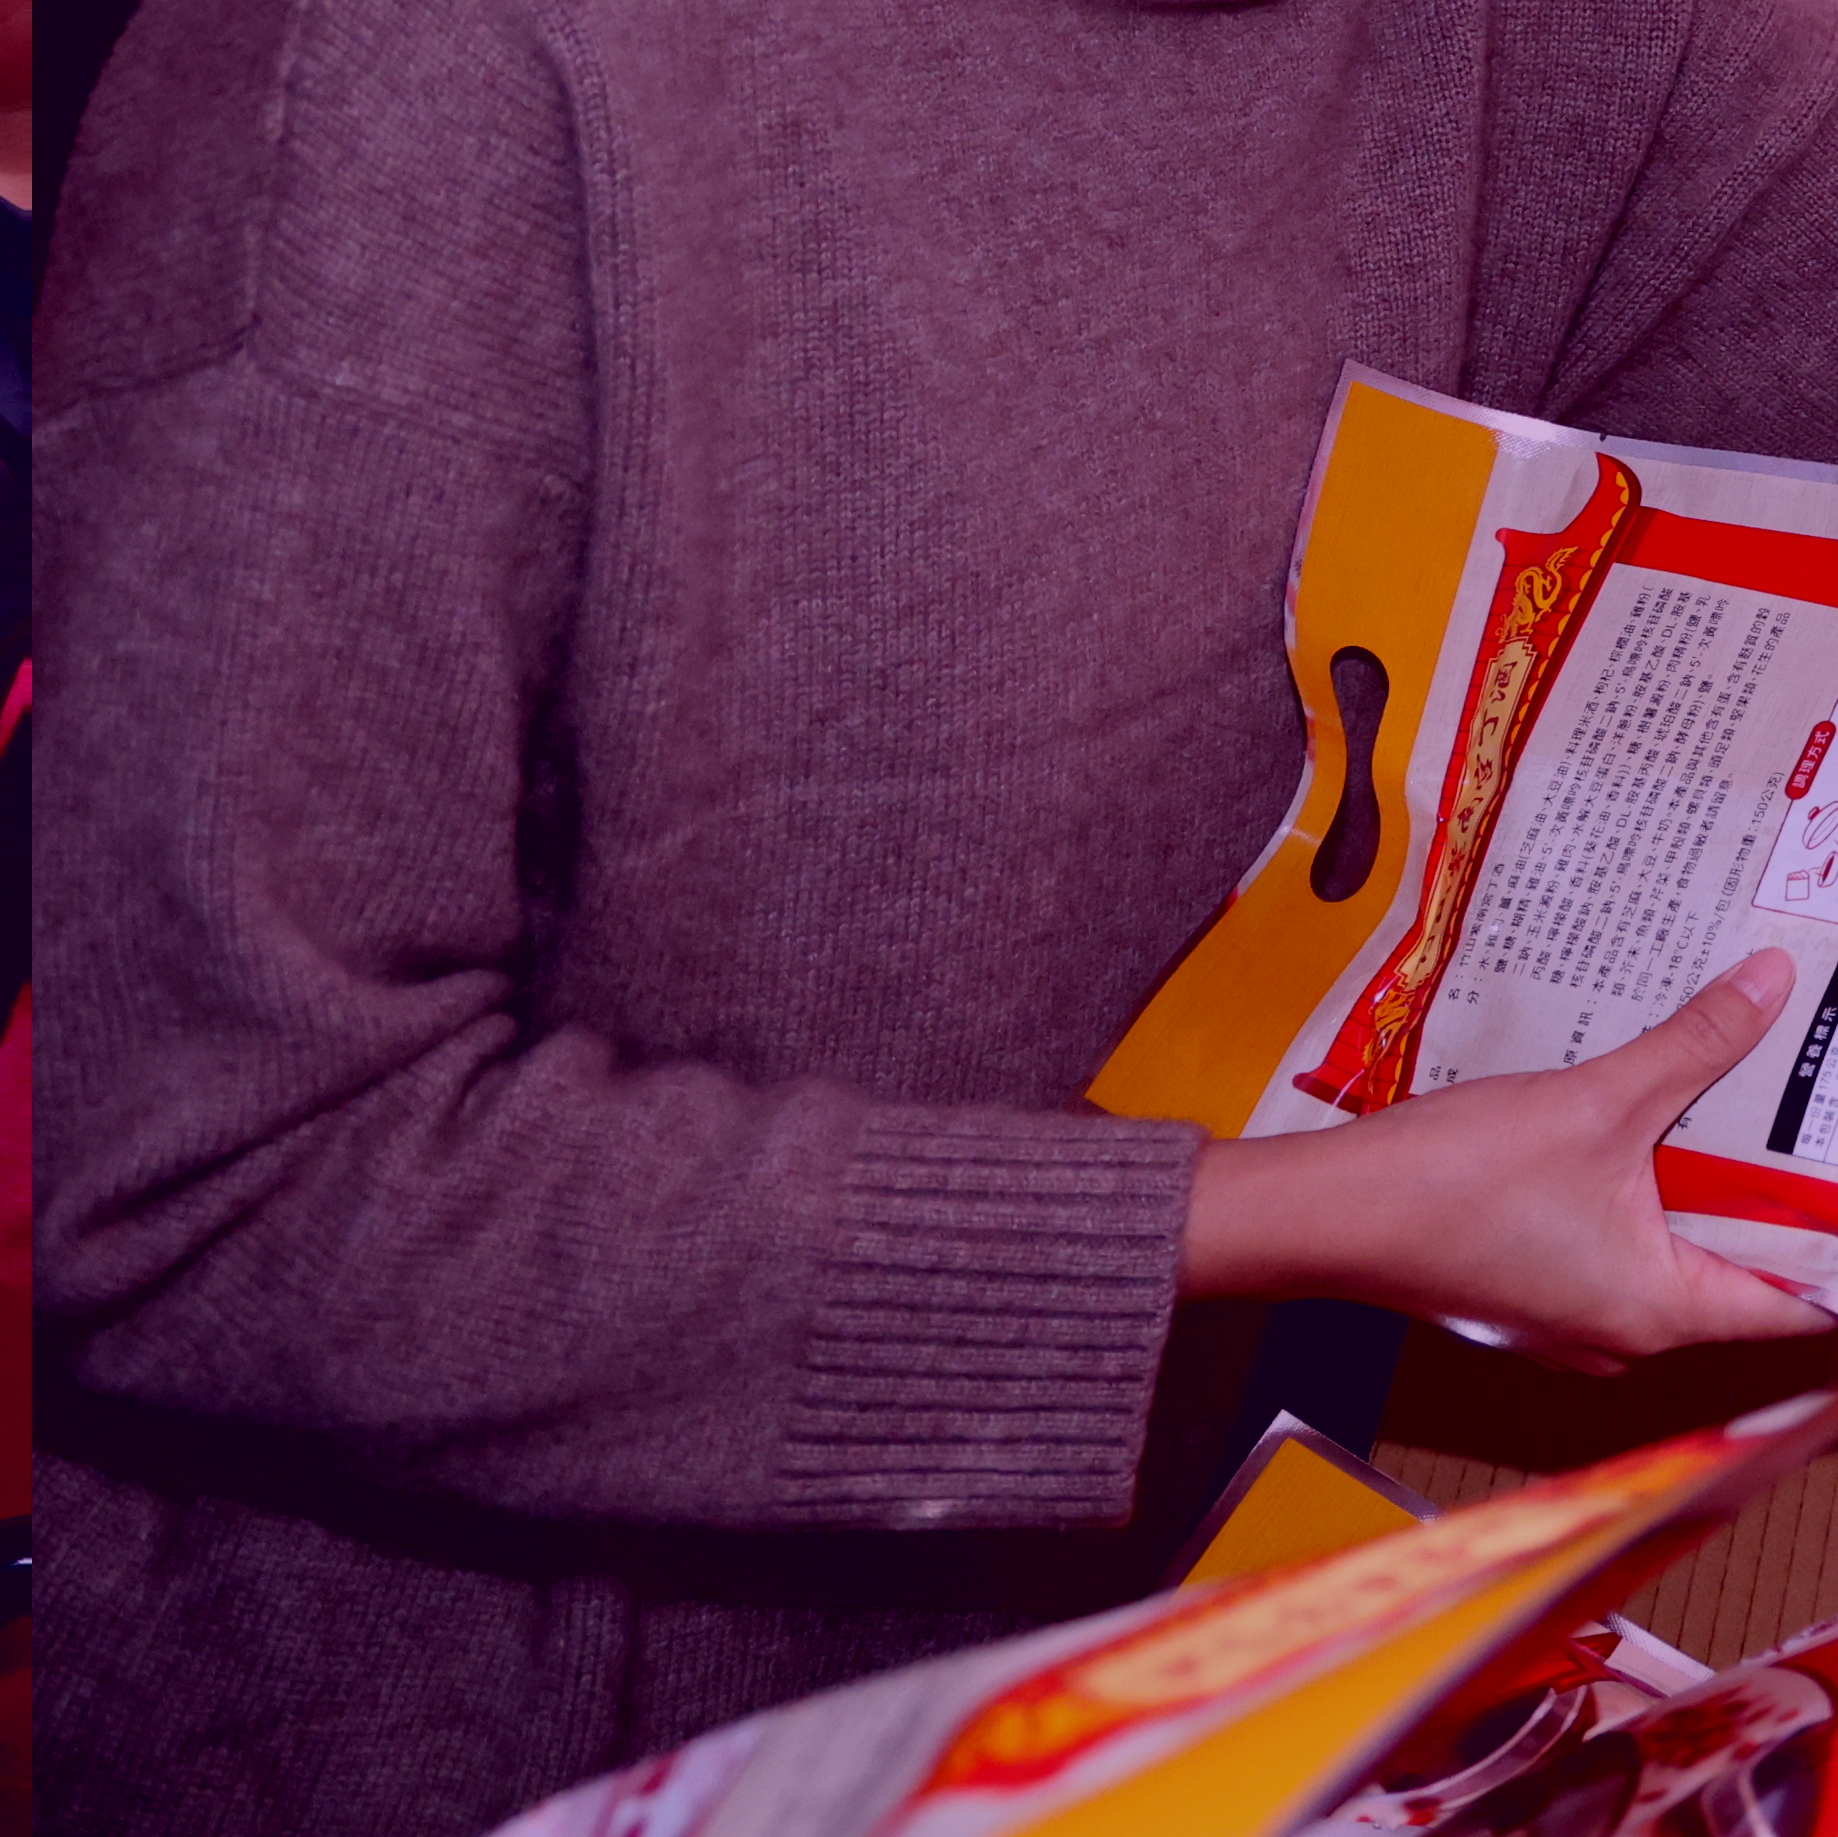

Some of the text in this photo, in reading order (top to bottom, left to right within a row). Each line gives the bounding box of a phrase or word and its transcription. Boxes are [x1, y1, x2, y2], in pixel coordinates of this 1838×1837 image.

[1790, 726, 1831, 790] 調理方式
[1797, 1003, 1838, 1080] 營養標示
[1444, 1066, 1459, 1084] 成
